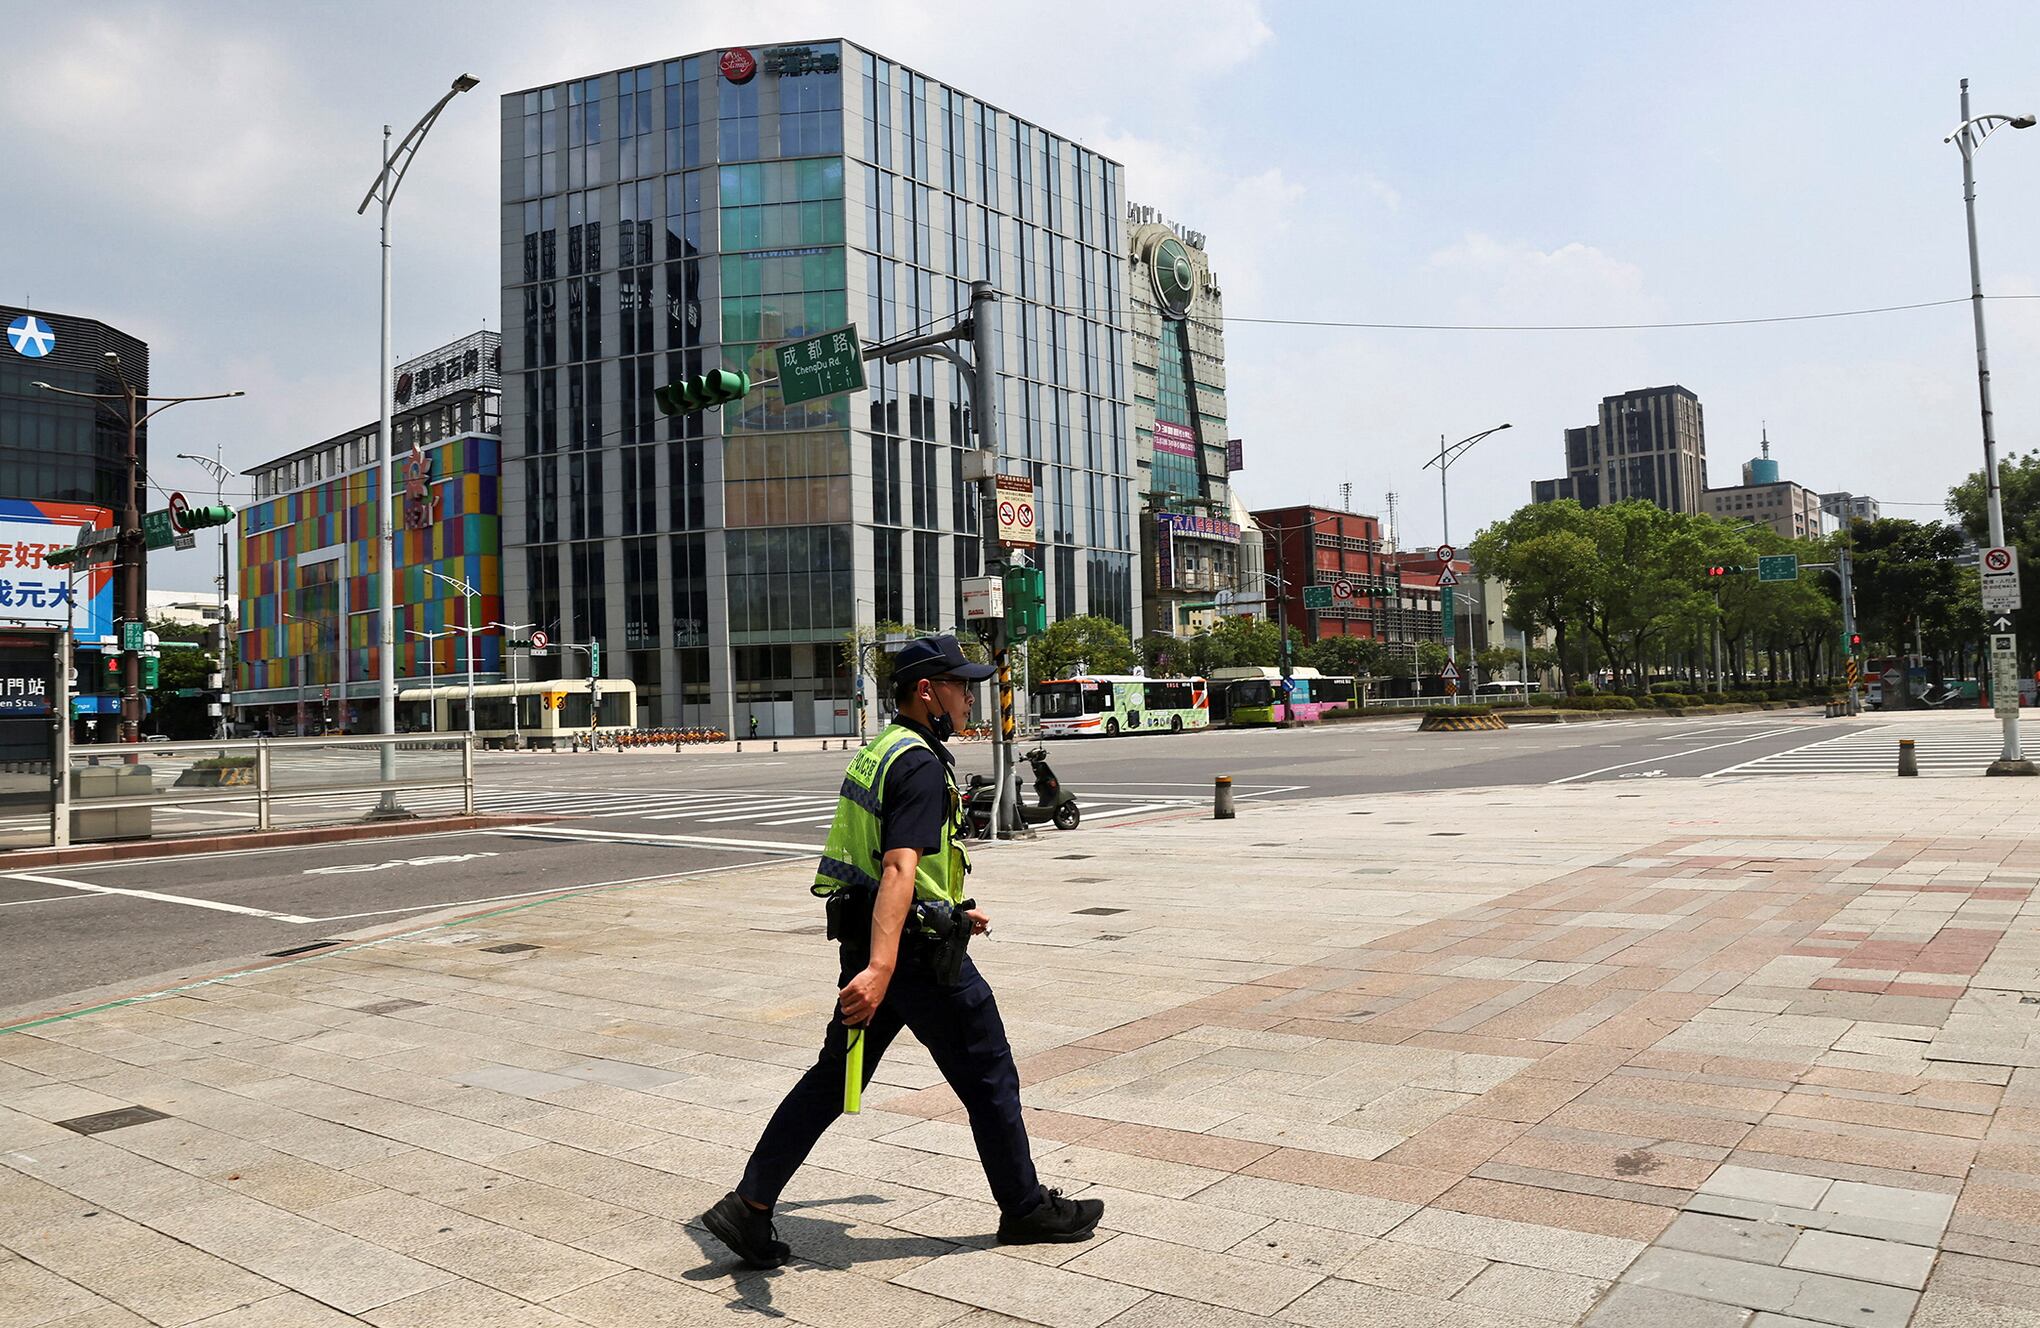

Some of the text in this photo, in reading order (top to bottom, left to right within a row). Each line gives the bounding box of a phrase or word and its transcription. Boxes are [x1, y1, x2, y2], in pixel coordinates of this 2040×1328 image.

[783, 333, 848, 367] 成都路
[795, 357, 841, 375] ChengDu Rd.
[0, 678, 45, 696] 門站
[15, 699, 37, 707] Sta.
[543, 697, 565, 710] 3 3
